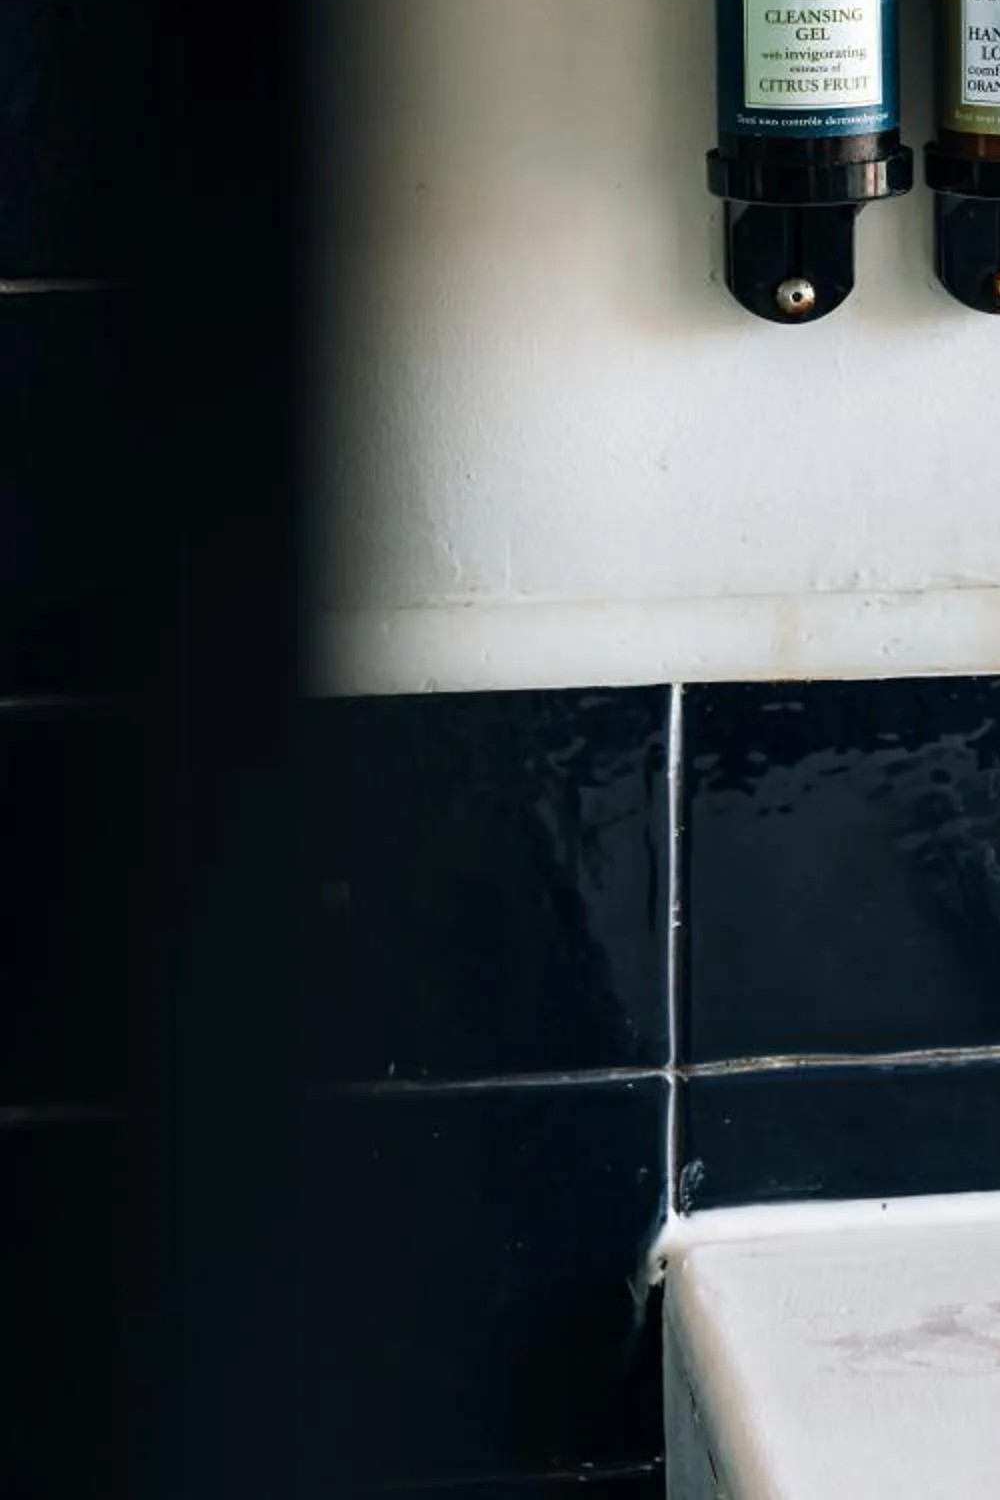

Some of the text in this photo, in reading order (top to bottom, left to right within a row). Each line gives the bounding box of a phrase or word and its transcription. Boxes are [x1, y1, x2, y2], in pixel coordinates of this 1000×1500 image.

[765, 8, 863, 25] CLEANSING
[795, 27, 831, 41] GEL
[785, 46, 867, 62] invigorating
[759, 76, 869, 92] CITRUS FRUIT
